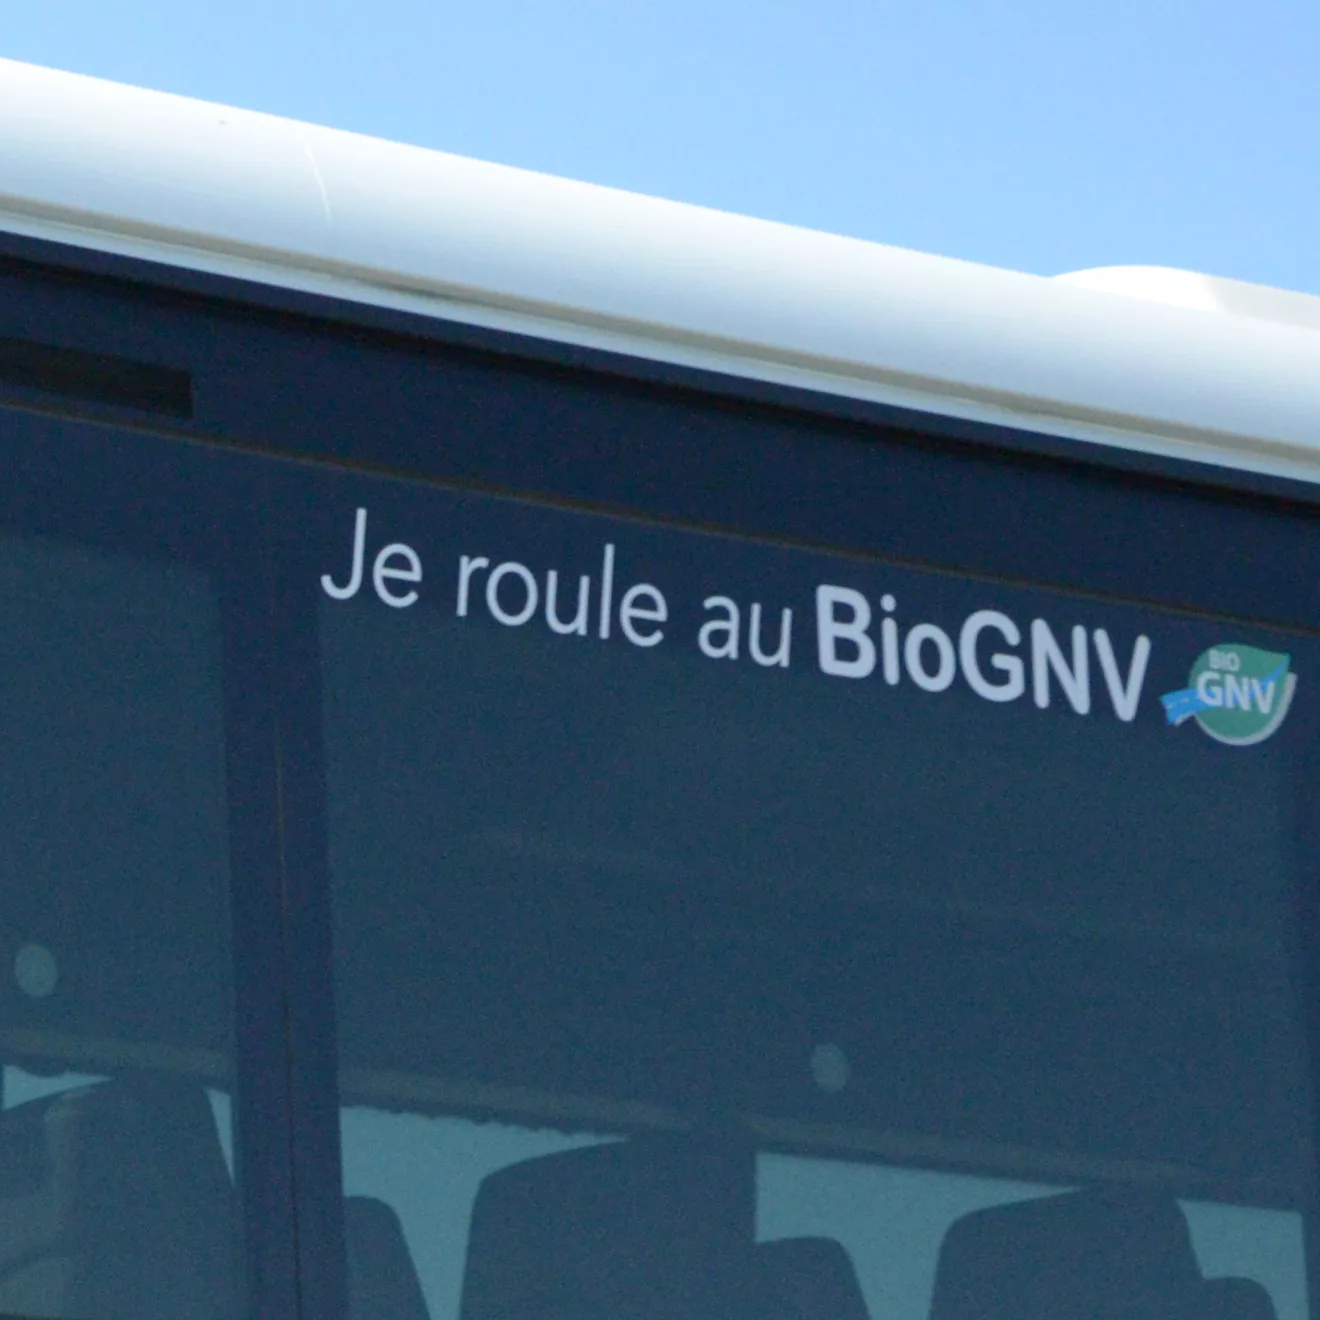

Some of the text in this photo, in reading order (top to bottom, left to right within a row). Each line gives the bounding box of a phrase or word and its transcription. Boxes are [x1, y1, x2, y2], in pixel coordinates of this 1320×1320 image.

[321, 508, 1152, 722] Je roule au BioGNV
[1207, 648, 1241, 672] BIO
[1196, 671, 1276, 714] GNV
